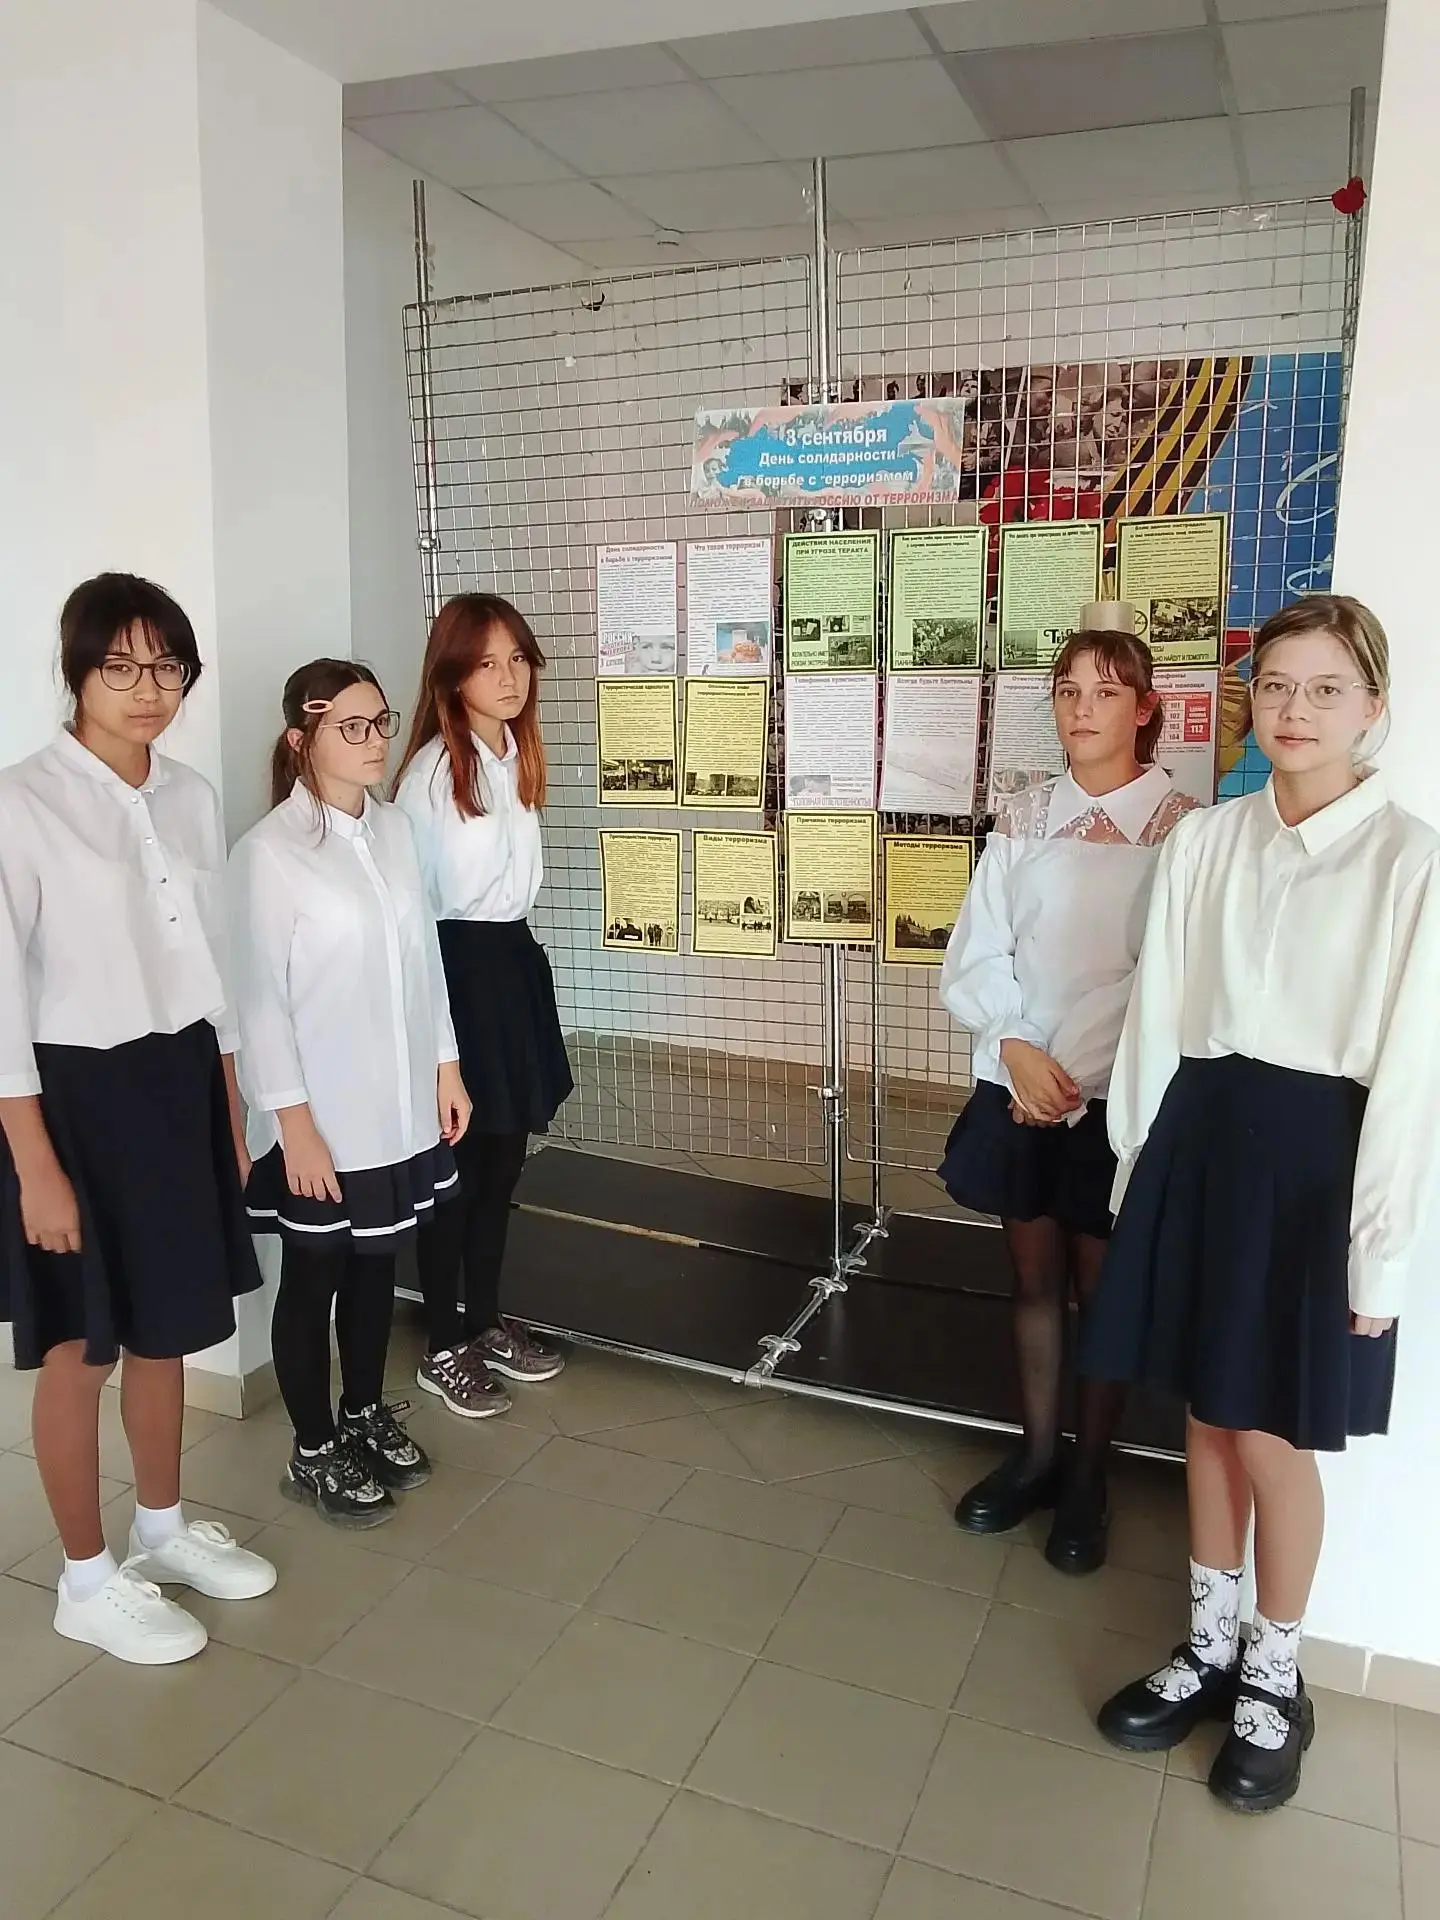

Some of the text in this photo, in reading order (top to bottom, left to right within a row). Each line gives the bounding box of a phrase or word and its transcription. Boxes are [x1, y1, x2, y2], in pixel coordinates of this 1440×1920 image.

[786, 426, 887, 448] 3 сентября
[759, 449, 896, 467] День солидарности
[756, 474, 805, 489] борьбе
[808, 477, 816, 486] с
[815, 493, 861, 506] РОССИЮ
[865, 493, 880, 505] ОТ
[883, 489, 959, 505] ТЕРРОРИЗМА
[622, 544, 664, 552] солидарности
[792, 538, 871, 548] ДЕЙСТВИЯ НАСЕЛЕНИЯ
[1190, 724, 1204, 734] 112
[796, 816, 826, 824] Причины
[703, 834, 767, 844] Виды терроризма
[922, 842, 963, 850] терроризма
